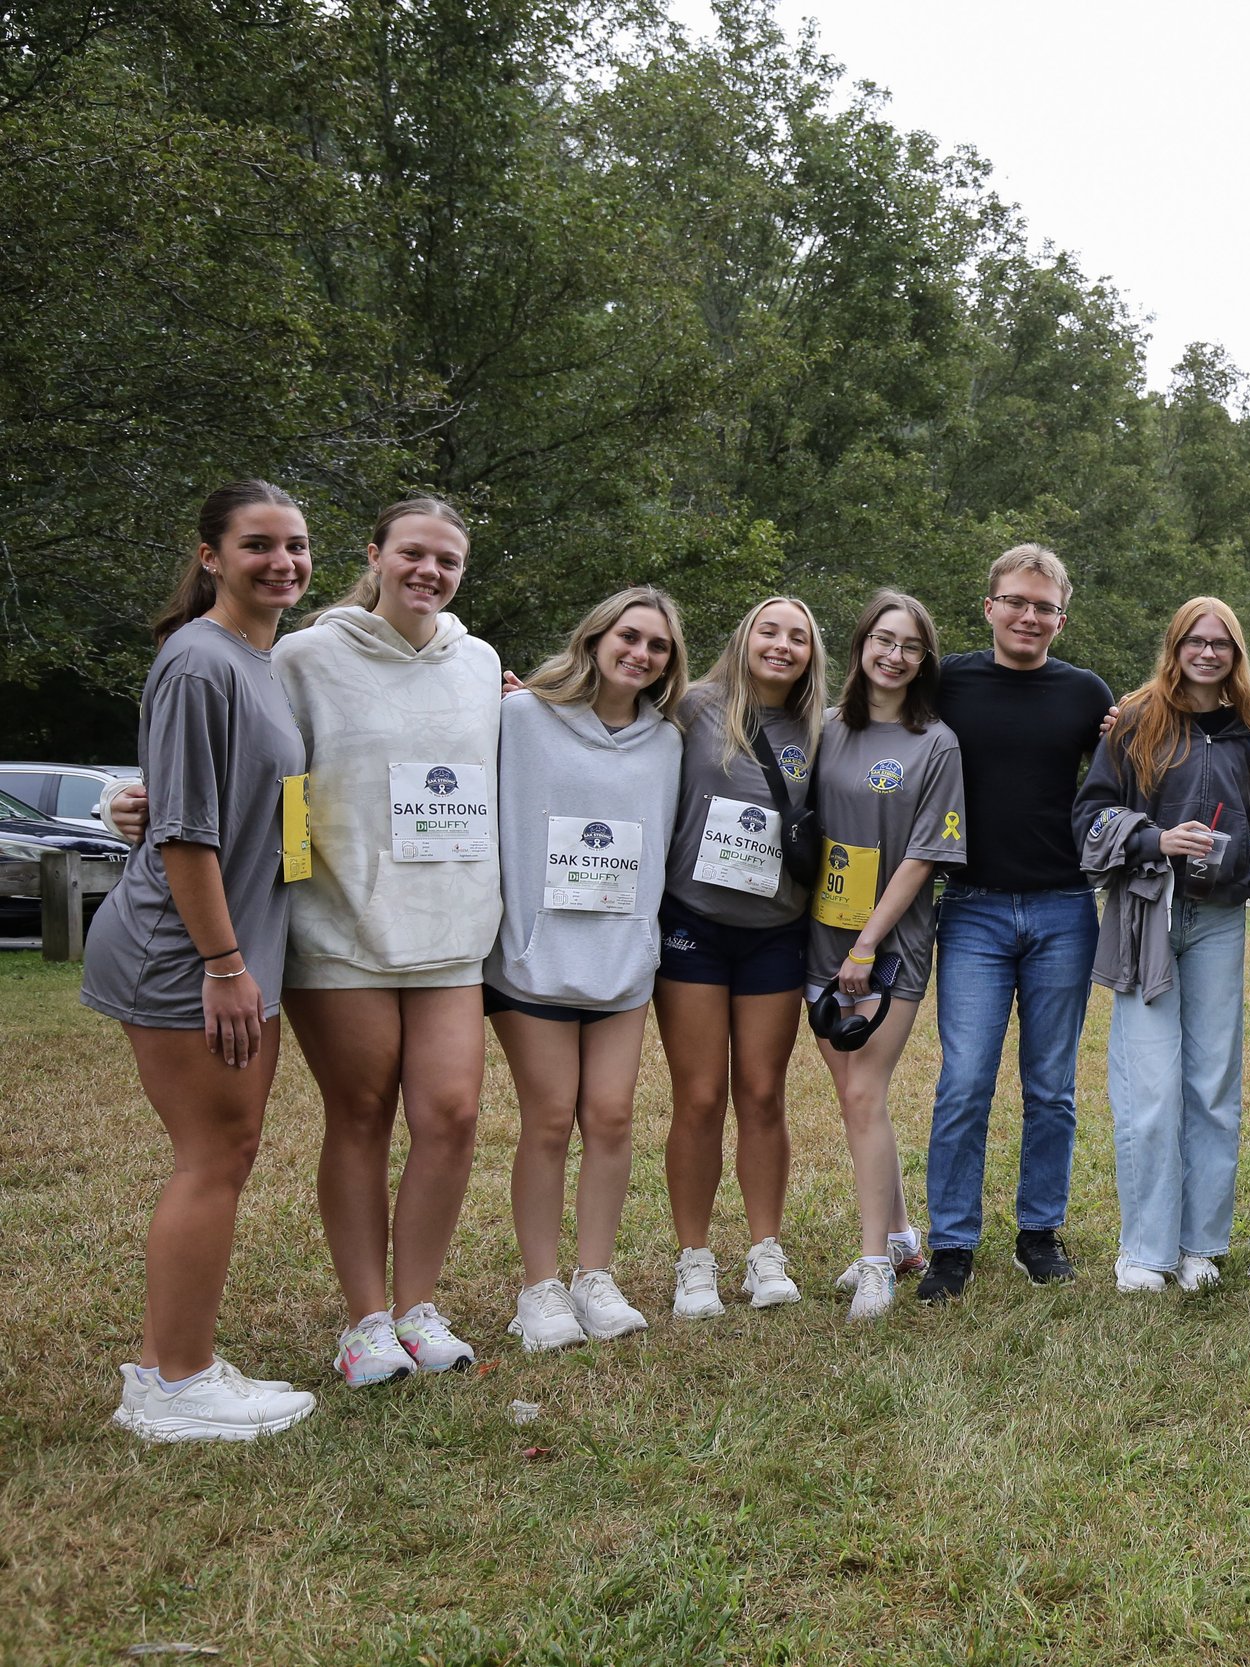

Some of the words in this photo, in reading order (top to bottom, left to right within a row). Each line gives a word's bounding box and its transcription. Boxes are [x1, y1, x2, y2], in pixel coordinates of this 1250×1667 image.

[393, 803, 425, 815] SAK
[429, 803, 487, 815] STRONG
[428, 820, 469, 828] DUFFY
[704, 830, 732, 845] SAK
[735, 837, 783, 859] STRONG
[549, 853, 578, 866] SAK
[582, 856, 639, 871] STRONG
[731, 851, 766, 866] DUFFY
[580, 872, 620, 881] DUFFY
[827, 872, 844, 894] 90
[169, 1400, 214, 1418] HOKA
